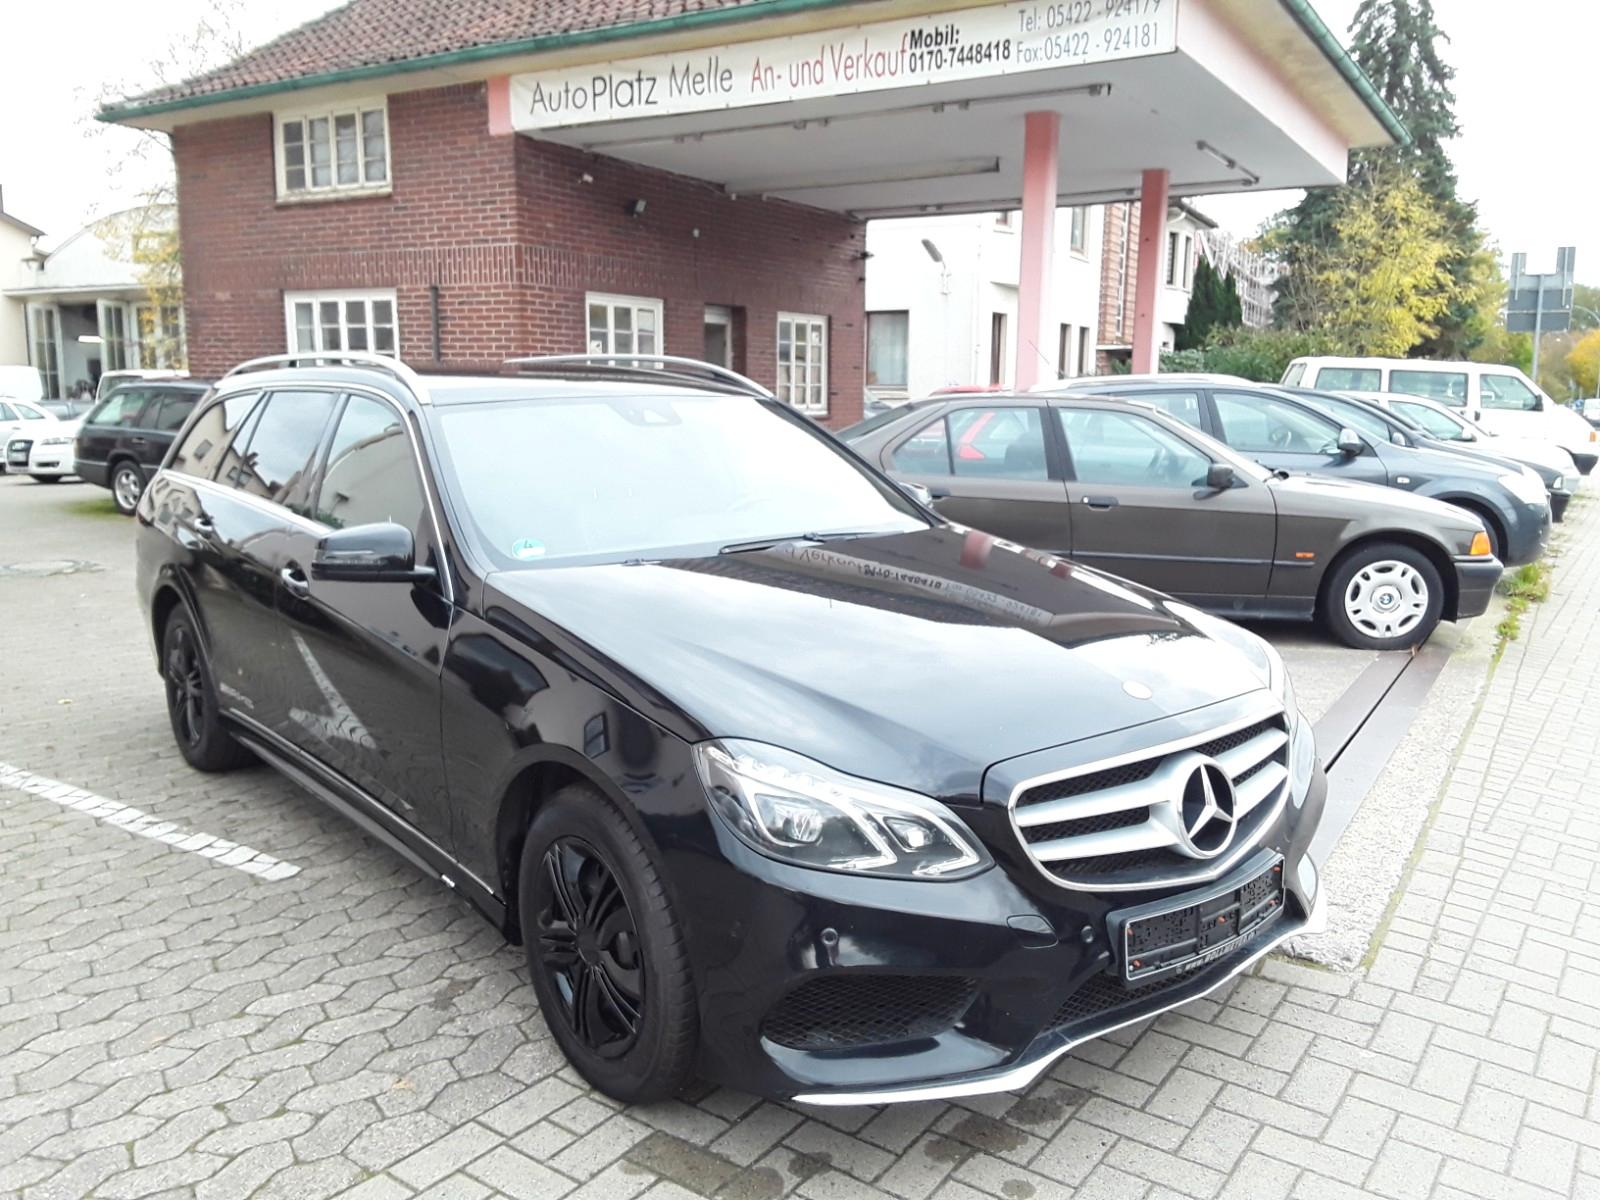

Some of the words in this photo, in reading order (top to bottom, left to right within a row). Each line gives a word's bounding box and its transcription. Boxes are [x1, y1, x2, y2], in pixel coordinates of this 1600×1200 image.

[1018, 8, 1041, 32] Tel:
[1047, 0, 1092, 28] 05422
[910, 23, 960, 50] Mobil:
[1104, 21, 1158, 53] 924181
[669, 56, 733, 98] Melle
[751, 56, 782, 92] An-
[789, 44, 825, 88] und
[830, 32, 908, 81] Verkauf
[909, 39, 1011, 73] 0170-7448418
